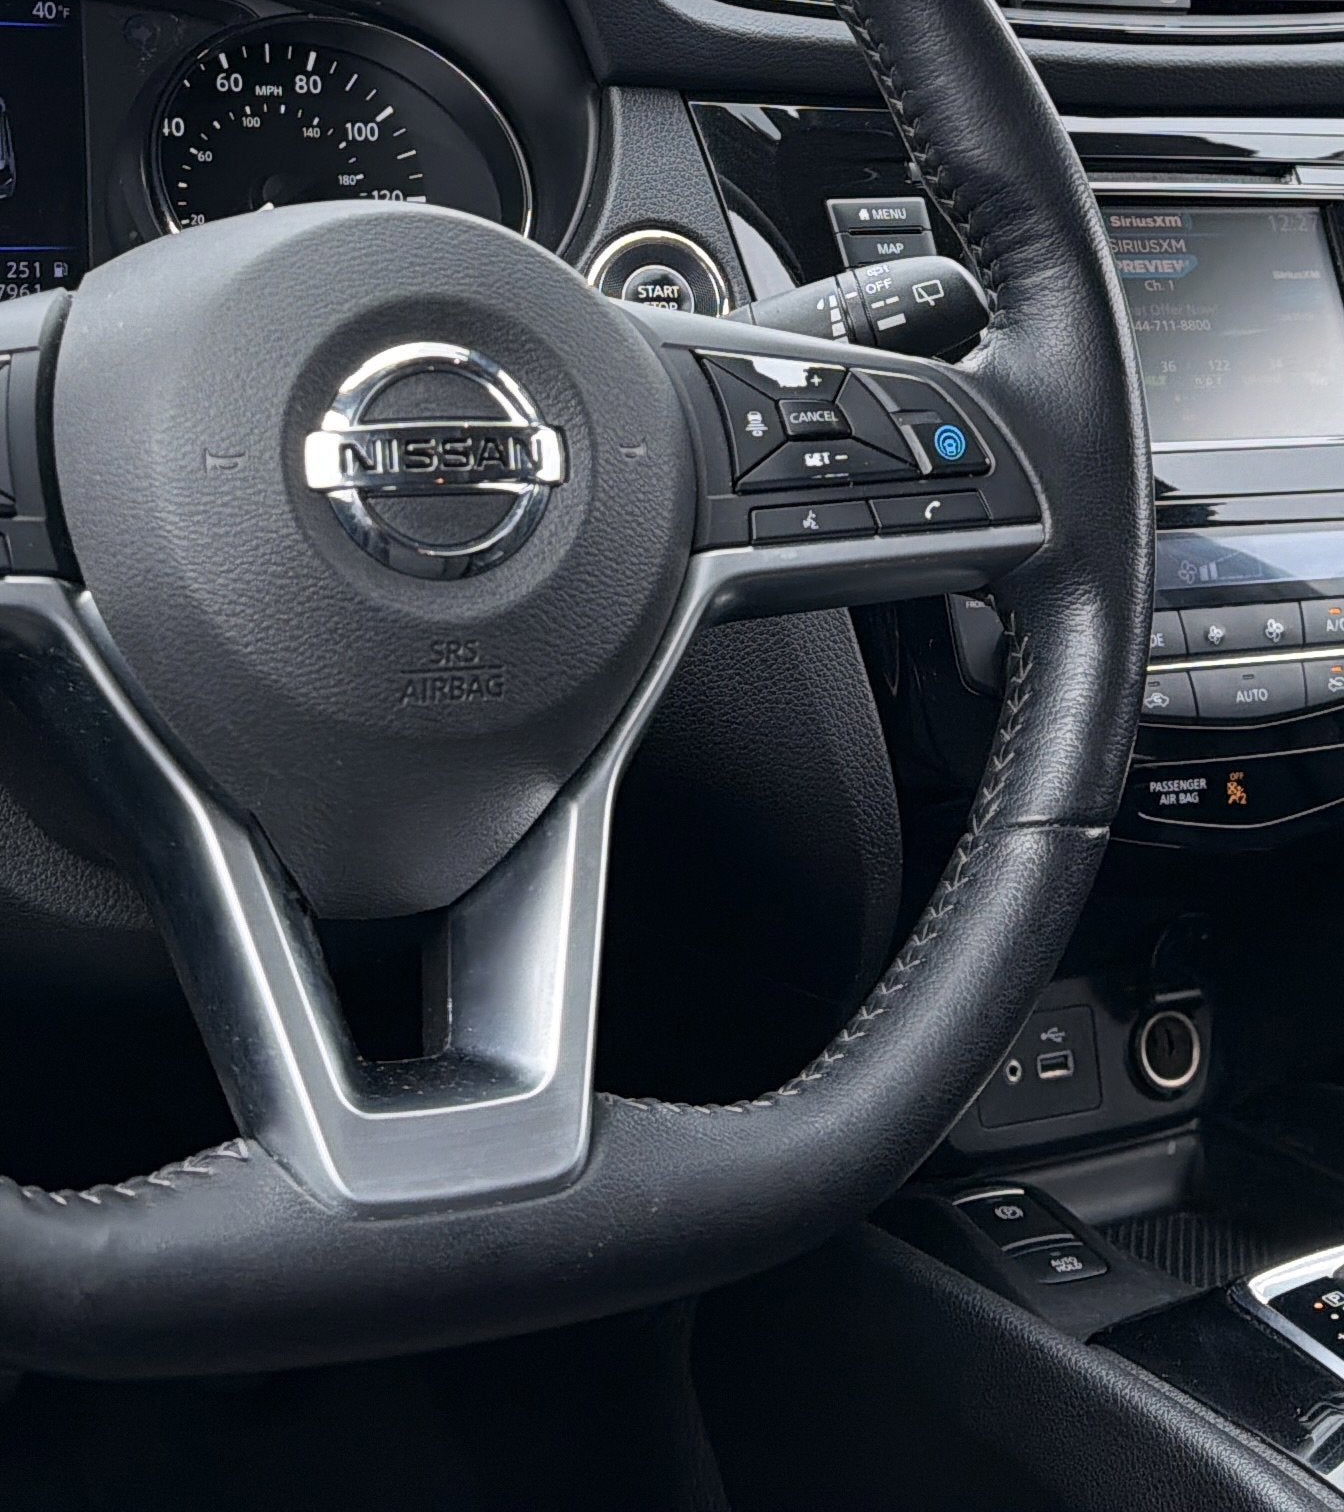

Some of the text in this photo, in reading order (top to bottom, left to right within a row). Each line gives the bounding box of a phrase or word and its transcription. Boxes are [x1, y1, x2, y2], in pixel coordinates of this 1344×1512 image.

[216, 73, 243, 93] 60
[294, 74, 322, 94] 80
[255, 85, 283, 97] MPH
[242, 116, 261, 128] 100
[302, 126, 321, 138] 140
[345, 121, 379, 142] 100
[197, 150, 213, 162] 60
[338, 174, 356, 186] 180
[190, 214, 205, 226] 20
[871, 208, 907, 220] MENU
[876, 242, 904, 254] MAP
[1109, 238, 1187, 253] SIRIUSXM
[6, 261, 41, 279] 251
[637, 285, 680, 298] START
[865, 278, 892, 294] OFF
[789, 409, 839, 424] CANCEL
[338, 435, 544, 476] NISSAN
[428, 639, 480, 665] SRS
[398, 676, 506, 706] AIRBAG
[1235, 688, 1269, 703] AUTO
[1229, 772, 1244, 781] OFF
[1149, 777, 1207, 792] PASSENGER
[1159, 792, 1199, 805] AIR BAG
